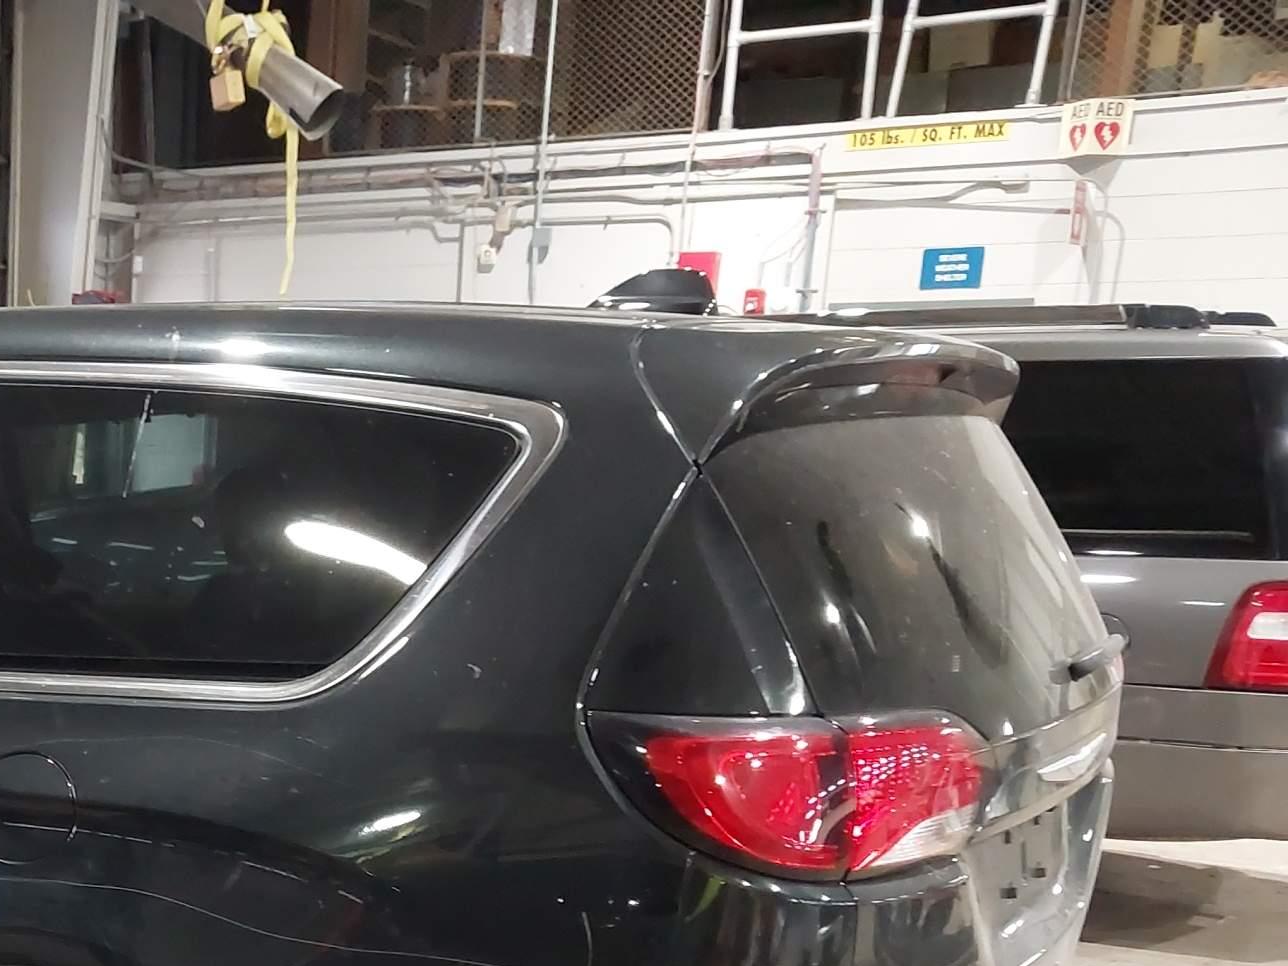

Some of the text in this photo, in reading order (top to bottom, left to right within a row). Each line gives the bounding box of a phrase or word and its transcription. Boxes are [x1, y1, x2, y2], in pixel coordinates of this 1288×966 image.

[1071, 103, 1090, 120] AED
[1096, 101, 1124, 117] AED
[852, 132, 876, 147] 105
[881, 129, 905, 145] lbs.
[922, 127, 943, 142] SQ.
[949, 125, 968, 140] FT.
[974, 122, 1007, 138] MAX
